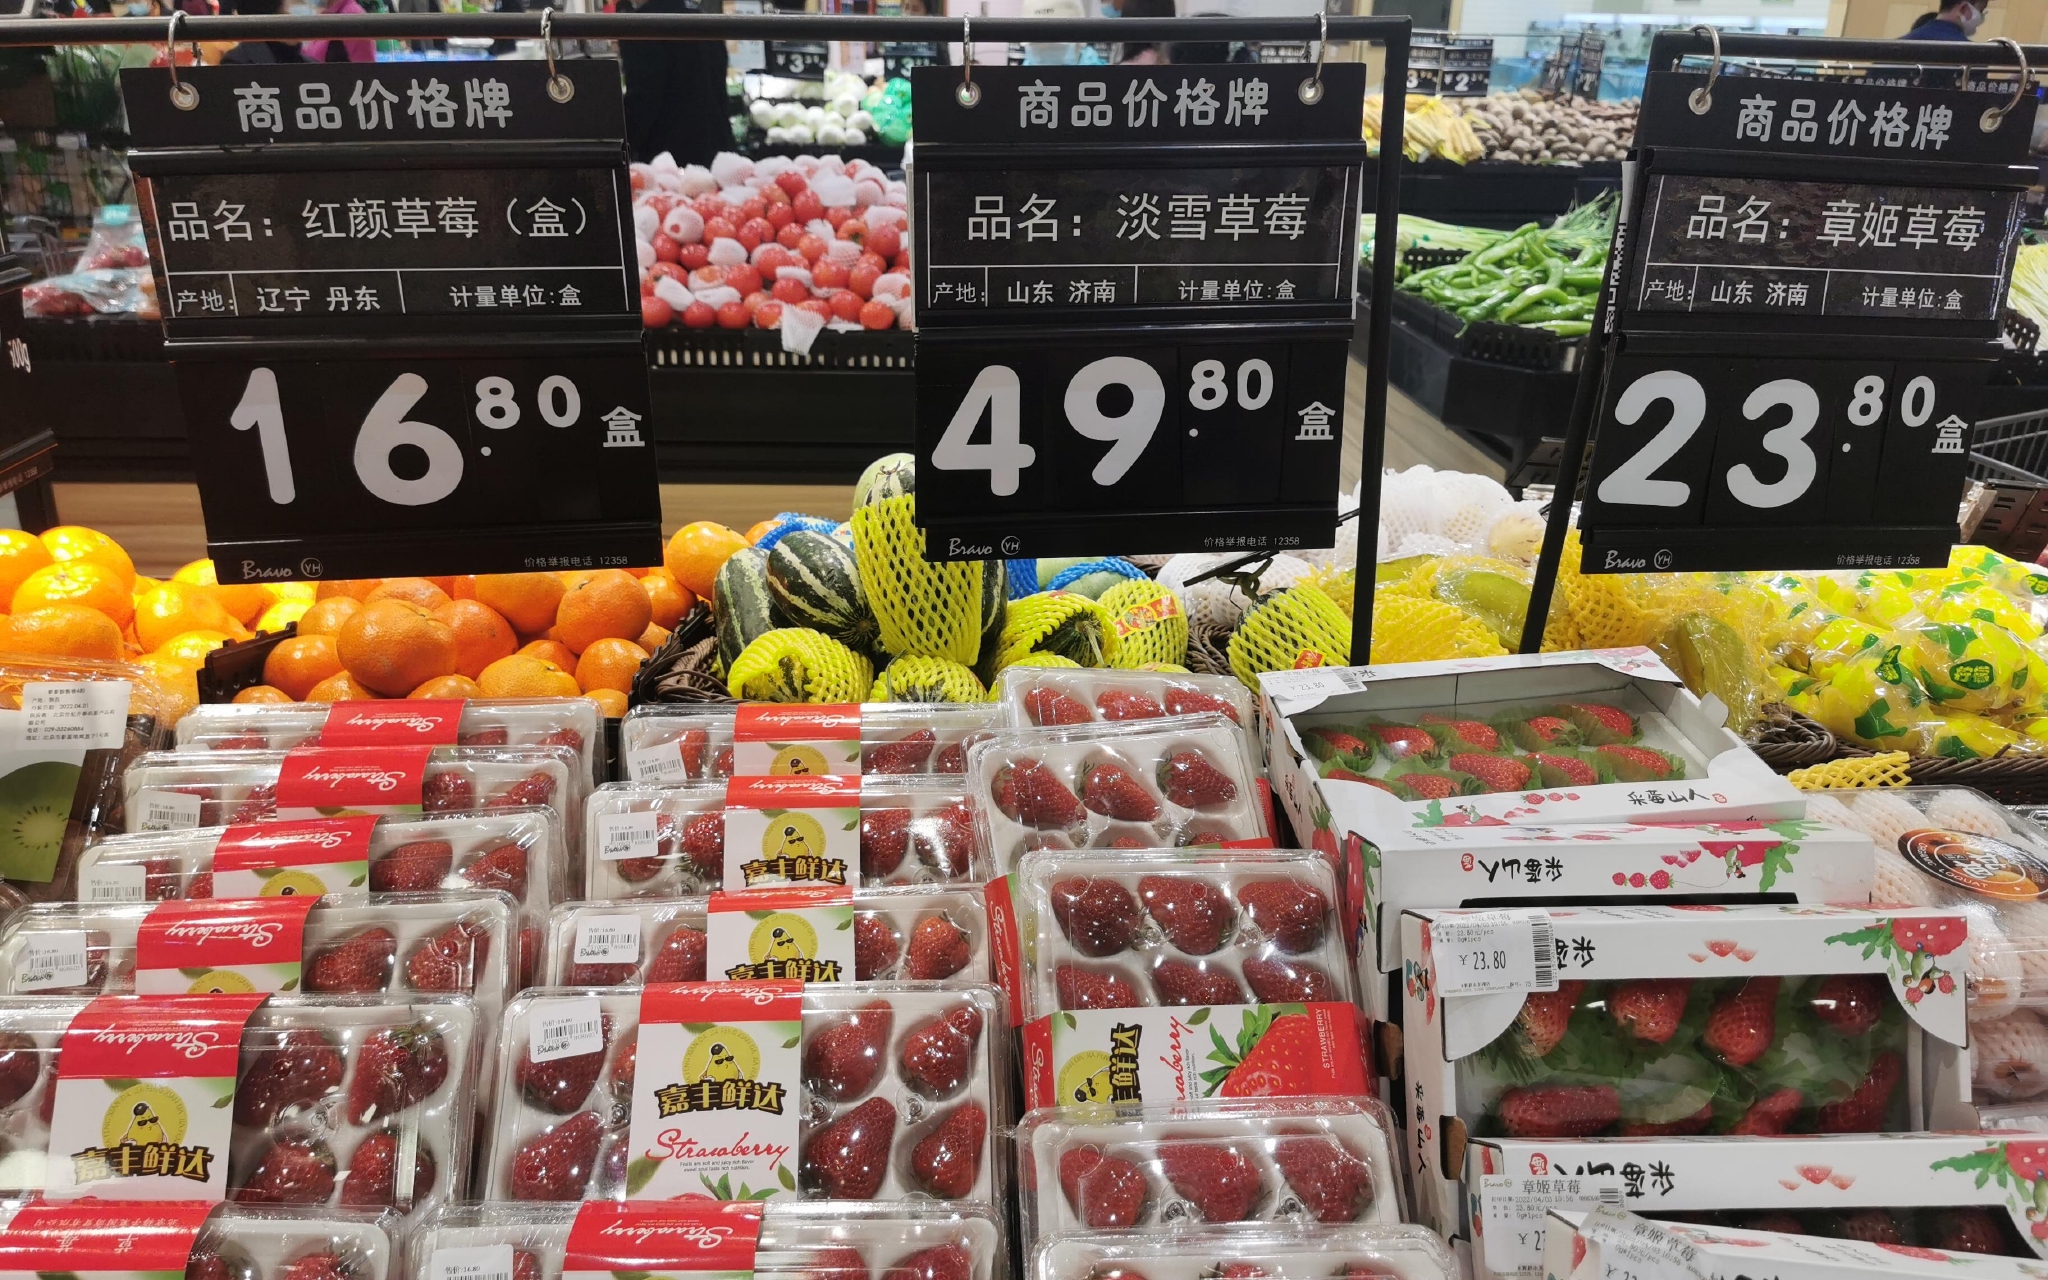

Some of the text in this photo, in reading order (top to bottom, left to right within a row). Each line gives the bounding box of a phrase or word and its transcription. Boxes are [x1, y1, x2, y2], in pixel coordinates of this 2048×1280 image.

[233, 77, 514, 133] 商品价格牌
[1018, 76, 1270, 130] 商品价格牌
[1736, 94, 1954, 150] 商品价格牌
[256, 287, 311, 312] 辽宁
[327, 286, 381, 312] 丹东
[1007, 281, 1054, 304] 山东
[1068, 280, 1117, 304] 济南
[1710, 281, 1753, 306] 山东
[1765, 281, 1809, 307] 济南
[600, 406, 645, 448] 盒
[1294, 400, 1336, 441] 盒
[1931, 414, 1968, 454] 盒
[948, 537, 993, 557] Bravo
[1203, 535, 1300, 548] 价格举报电话 12358
[241, 560, 293, 581] Bravo
[523, 554, 628, 569] 价格举报电话 12358
[1604, 549, 1646, 570] Bravo
[1836, 553, 1892, 566] 价格举报电话
[347, 712, 443, 732] Strawberry
[302, 766, 406, 791] Strawberry
[1938, 868, 1989, 888] LOQUAT
[165, 919, 283, 947] Strawberry
[669, 985, 783, 1005] Strawberry
[93, 1022, 219, 1059] Strawberry
[1316, 1007, 1331, 1069] STRAWBERRY
[656, 1081, 784, 1117] 嘉丰鲜达
[645, 1128, 789, 1171] Strawberry
[1483, 1178, 1503, 1188] Bravo
[1522, 1179, 1581, 1195] 章姬草莓
[1594, 1206, 1616, 1218] Bravo
[600, 1218, 734, 1249] Strawberry
[1633, 1221, 1698, 1262] 章姬草莓
